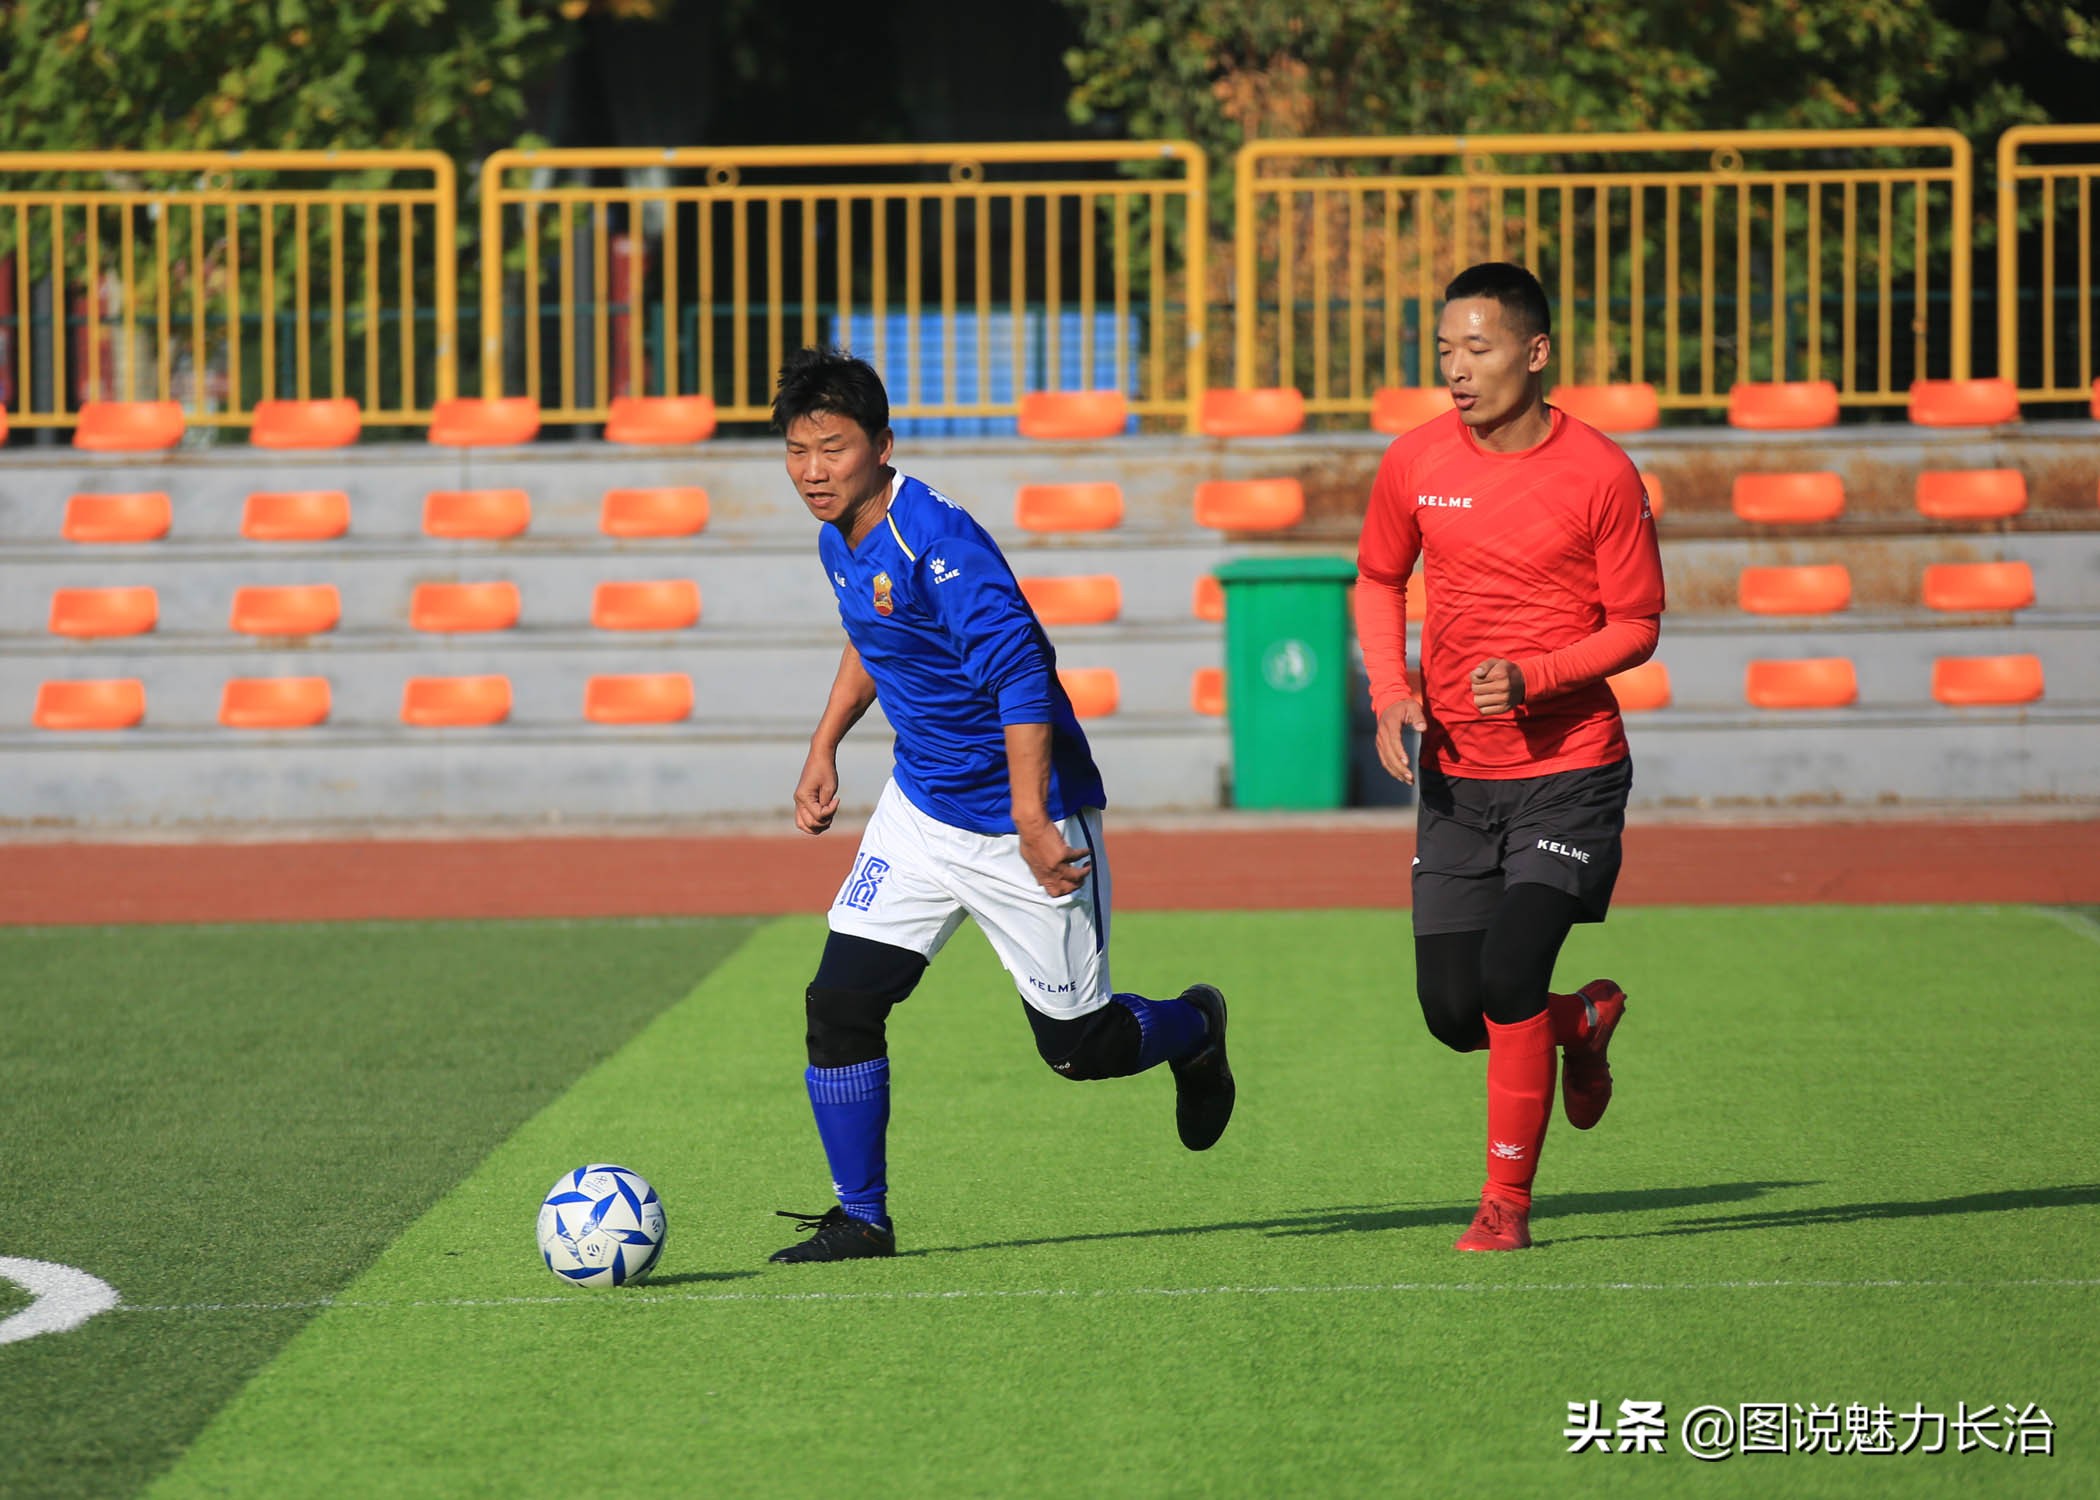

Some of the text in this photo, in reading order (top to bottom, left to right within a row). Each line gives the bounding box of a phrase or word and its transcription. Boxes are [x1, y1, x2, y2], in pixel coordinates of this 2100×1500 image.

[1417, 494, 1473, 509] KELME
[1536, 838, 1591, 864] KELME
[1028, 975, 1078, 994] KELME
